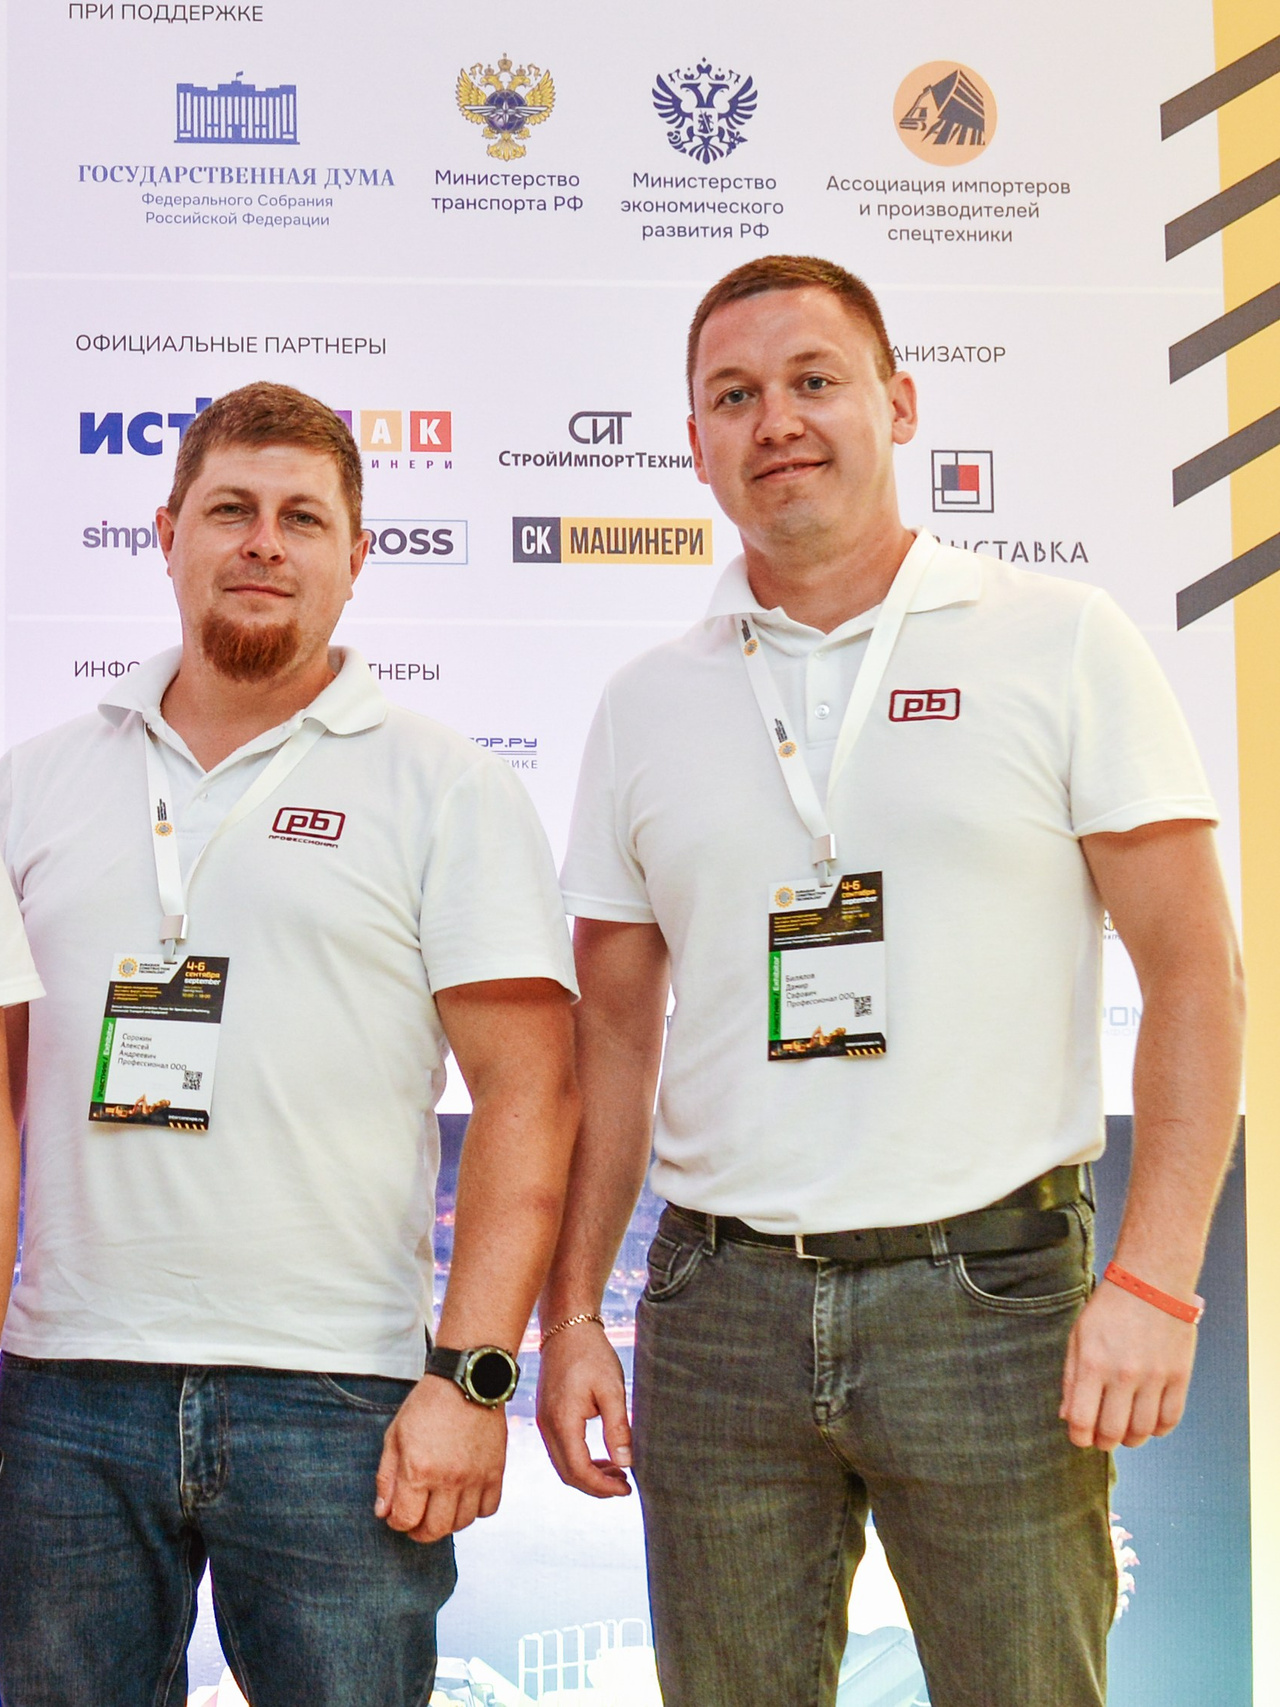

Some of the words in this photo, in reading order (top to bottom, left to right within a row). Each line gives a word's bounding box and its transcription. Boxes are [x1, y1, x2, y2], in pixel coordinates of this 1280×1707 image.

[69, 3, 113, 19] ПРИ
[122, 4, 263, 24] ПОДДЕРЖКЕ
[79, 165, 316, 187] ГОСУДАРСТВЕННАЯ
[324, 168, 394, 189] ДУМА
[436, 170, 579, 189] Министерство
[633, 172, 776, 192] Министерство
[827, 176, 945, 195] Ассоциация
[953, 181, 1070, 197] импортеров
[142, 193, 252, 208] Федерального
[258, 194, 333, 209] Собрания
[432, 198, 546, 214] транспорта
[554, 196, 583, 211] РФ
[621, 200, 783, 214] экономического
[146, 212, 237, 224] Российской
[242, 213, 329, 228] Федерации
[860, 204, 870, 215] и
[878, 202, 1039, 220] производителей
[643, 225, 732, 240] развития
[741, 223, 769, 238] РФ
[888, 229, 1012, 244] спецтехники
[76, 334, 257, 355] ОФИЦИАЛЬНЫЕ
[266, 337, 385, 354] ПАРТНЕРЫ
[569, 411, 632, 444] СИТ
[82, 520, 158, 556] simpl
[521, 526, 552, 554] СК
[570, 527, 704, 556] МАШИНЕРИ
[185, 971, 220, 979] сентября
[119, 1050, 156, 1059] Андреевич
[120, 1042, 149, 1051] Алексей
[118, 1058, 169, 1069] Профессионал
